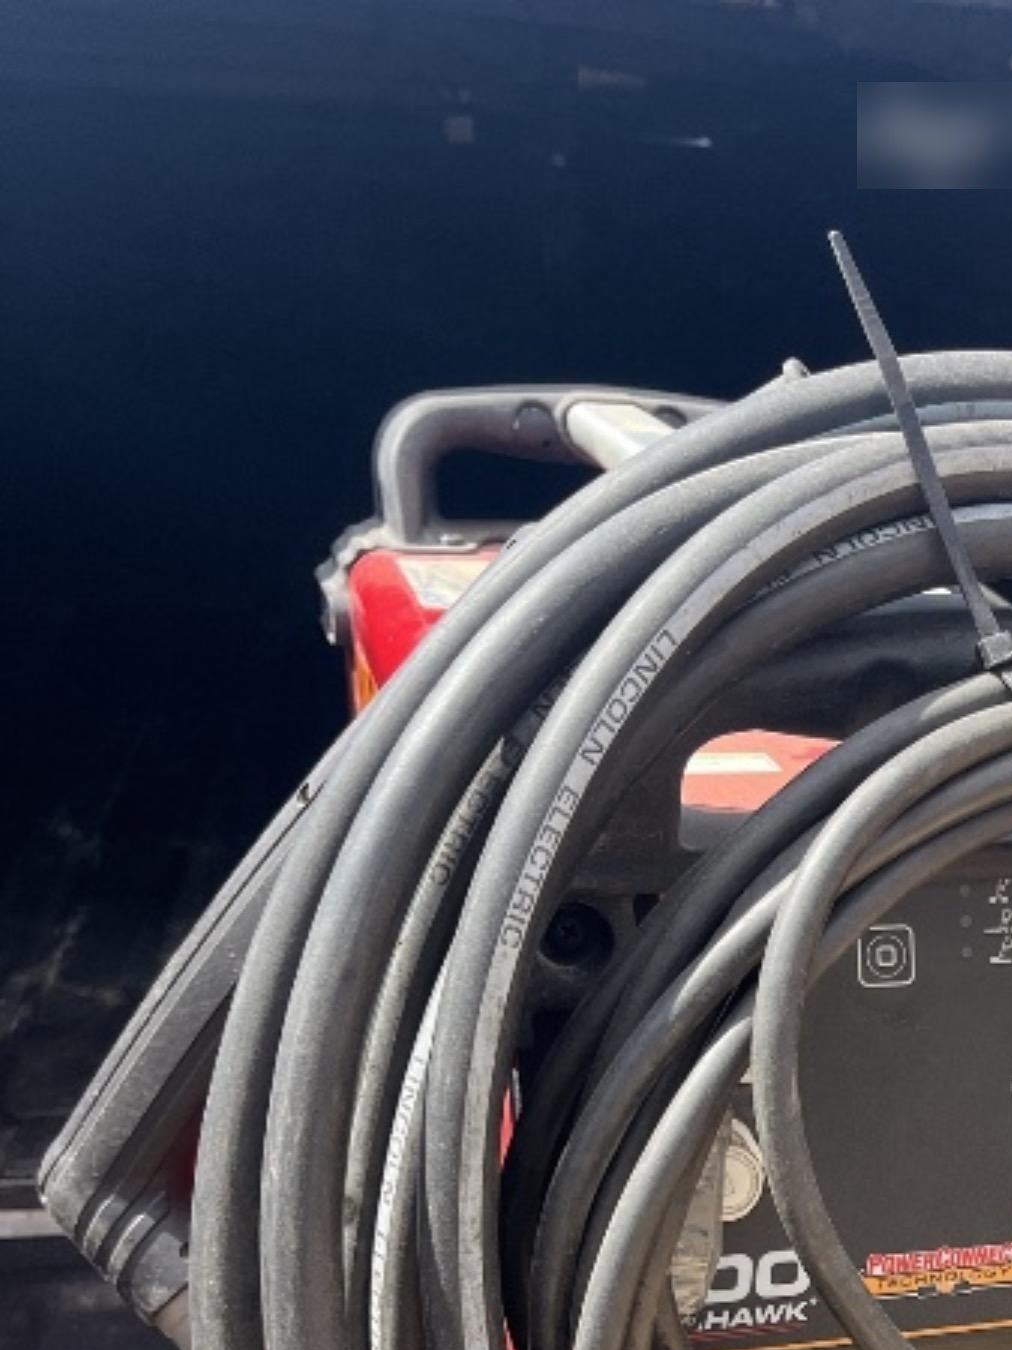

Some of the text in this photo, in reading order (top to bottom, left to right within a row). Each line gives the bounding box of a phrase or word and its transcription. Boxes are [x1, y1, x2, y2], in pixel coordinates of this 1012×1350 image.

[581, 629, 677, 765] LINCOLN
[501, 785, 579, 949] ELECTRIC
[702, 1301, 809, 1330] HAWK
